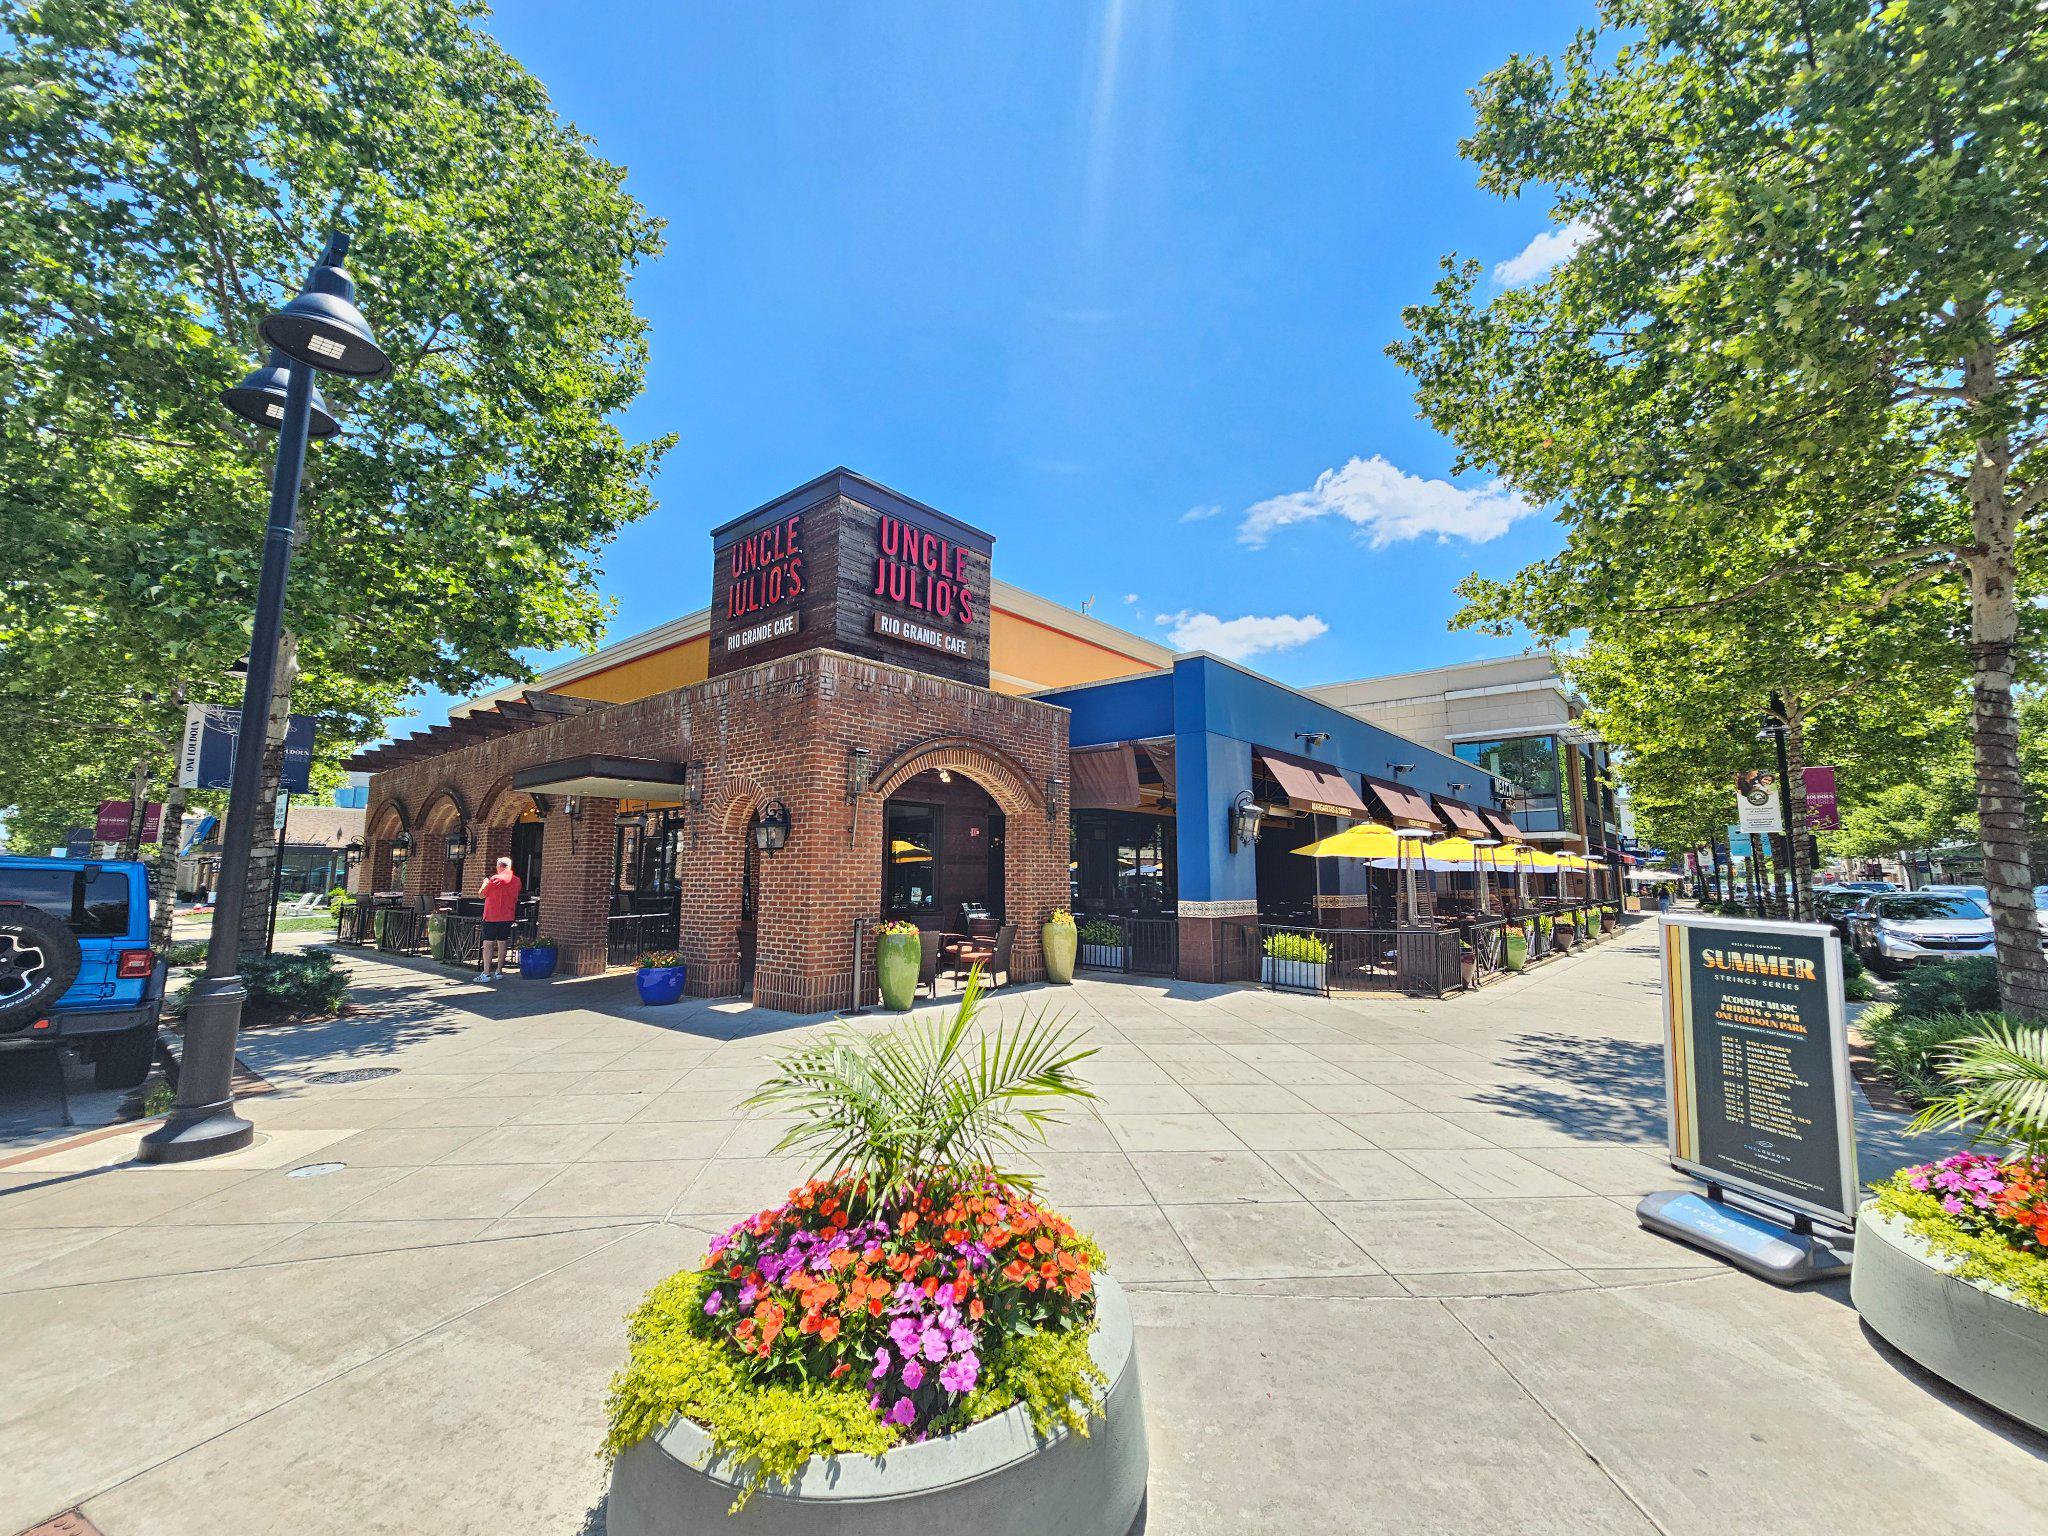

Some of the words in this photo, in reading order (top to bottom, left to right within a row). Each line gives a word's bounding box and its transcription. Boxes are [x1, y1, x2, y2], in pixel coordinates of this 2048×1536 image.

[731, 515, 800, 578] UNCLE
[879, 515, 970, 583] UNCLE
[727, 558, 802, 621] JULIO'S
[875, 558, 974, 624] JULIO'S
[727, 634, 740, 651] RIO
[742, 624, 772, 647] GRANDE
[774, 616, 794, 639] CAFE
[881, 615, 900, 635] RIO
[903, 624, 942, 648] GRANDE
[945, 636, 968, 655] CAFE
[187, 720, 200, 758] LOUDOUN
[186, 758, 196, 772] ONE
[1701, 948, 1816, 980] SUMMER
[1714, 973, 1756, 985] STRINGS
[1762, 979, 1799, 991] SERIES
[1720, 1002, 1761, 1016] FRIDAYS
[1721, 994, 1766, 1008] ACOUSTIC
[1766, 1001, 1797, 1013] MUSIC
[1715, 1010, 1732, 1020] ONE
[1734, 1014, 1778, 1028] LOUDOUN
[1779, 1021, 1807, 1033] PARK
